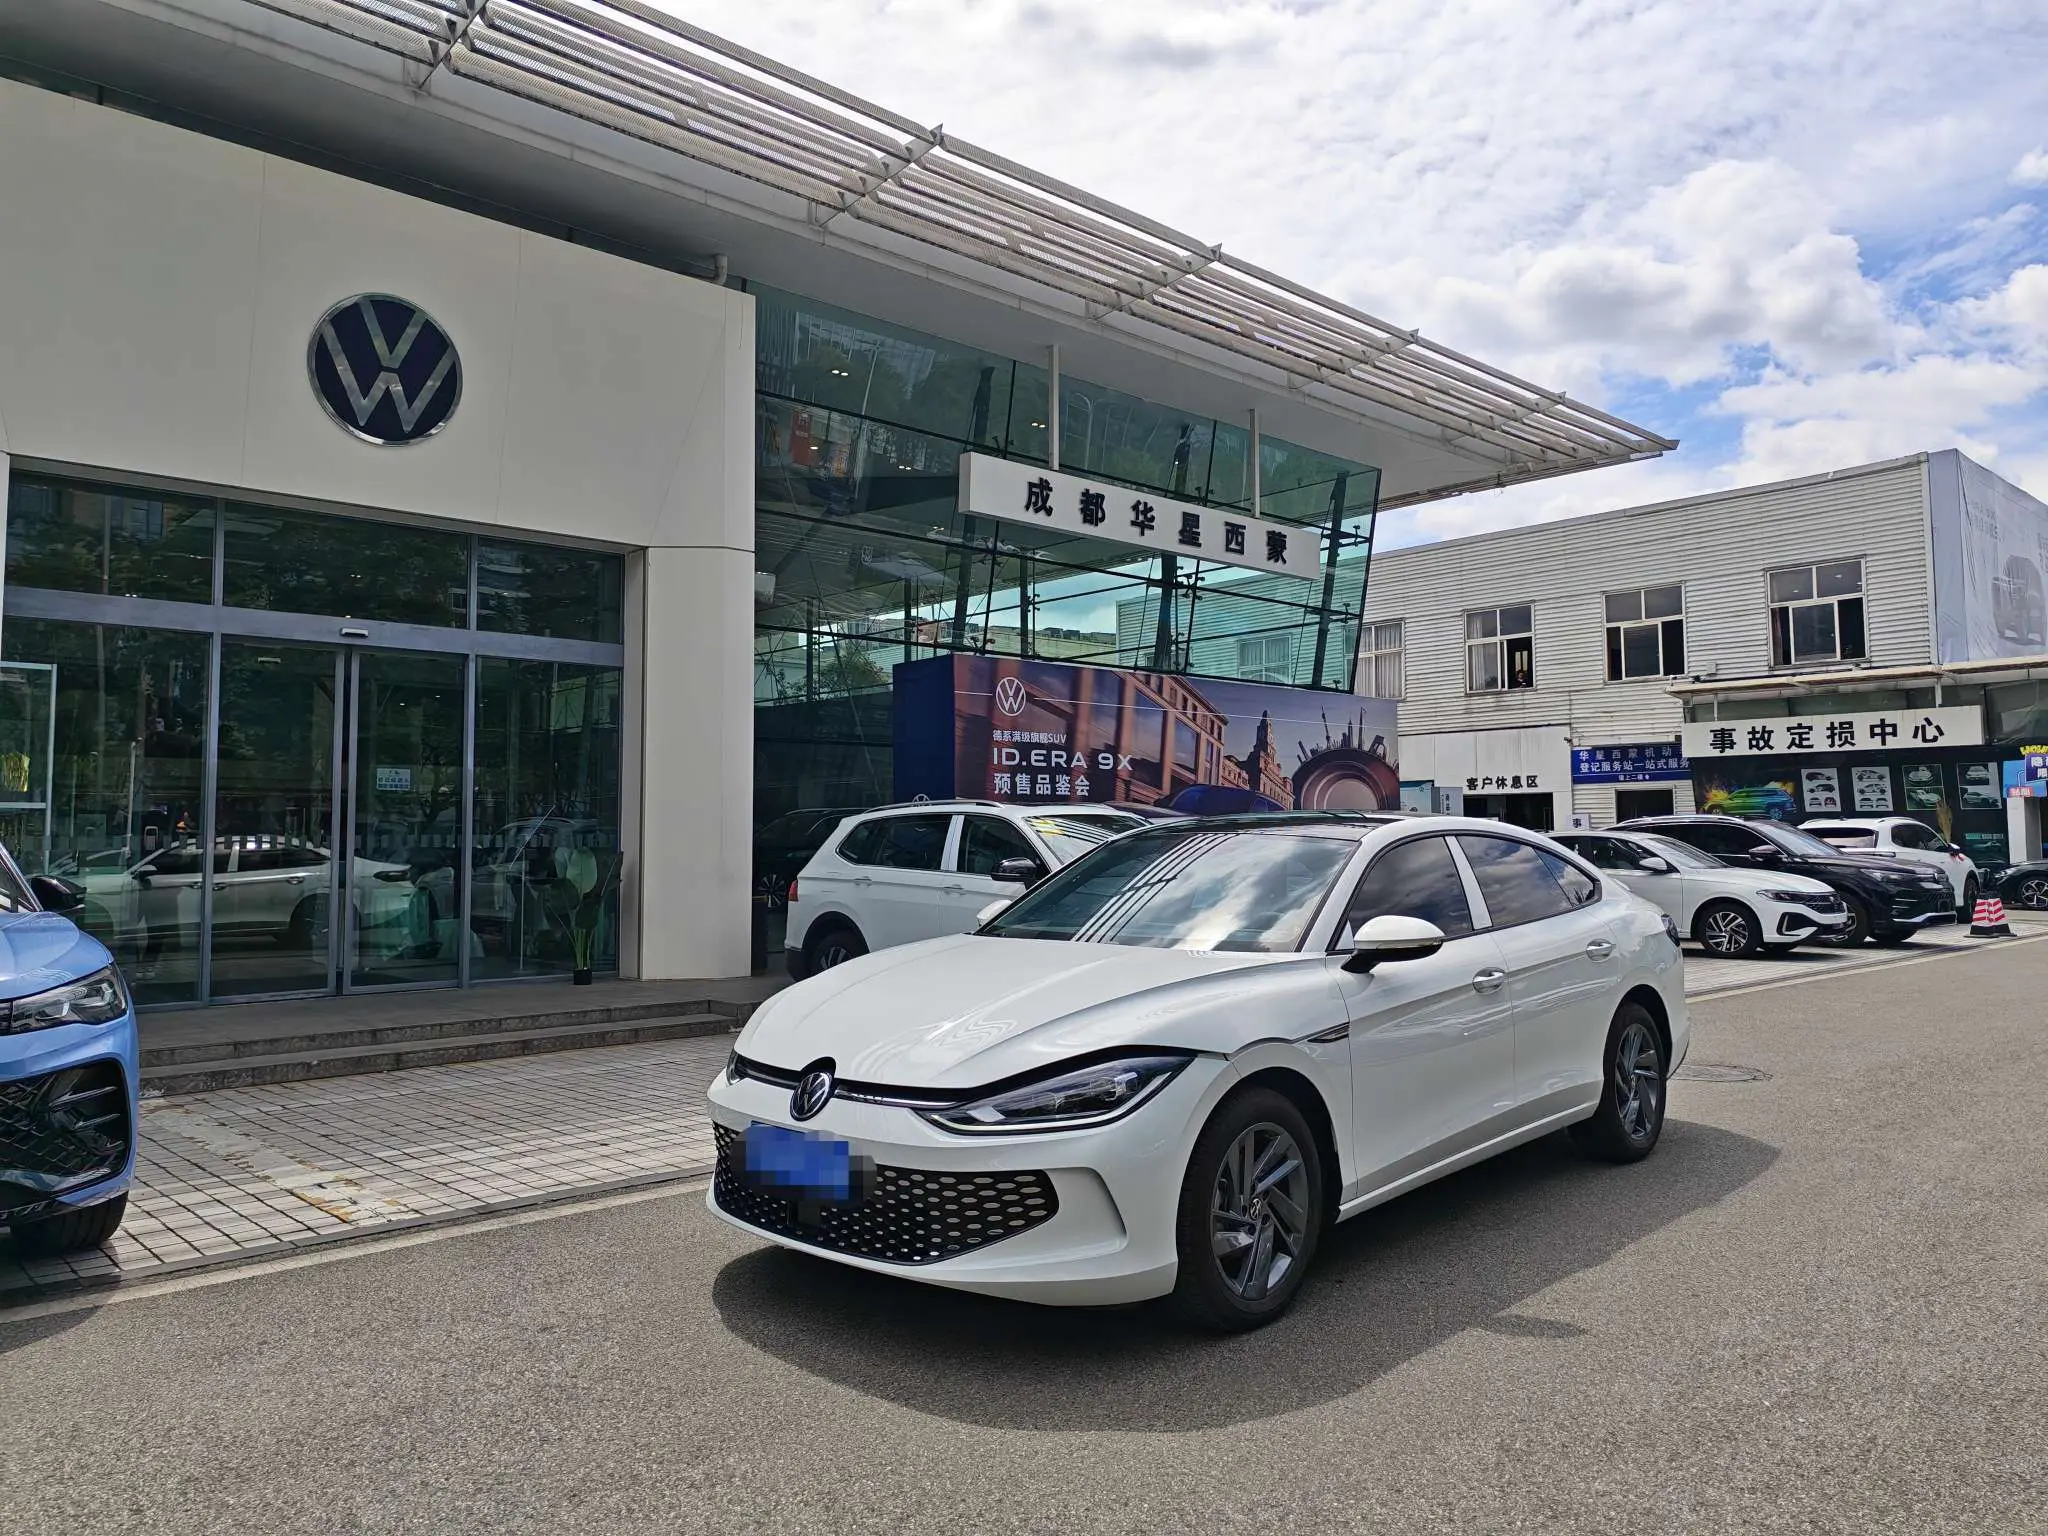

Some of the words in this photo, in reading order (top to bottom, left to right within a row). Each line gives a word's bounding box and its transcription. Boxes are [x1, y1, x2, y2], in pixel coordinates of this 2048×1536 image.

[309, 293, 463, 445] VW
[1025, 477, 1288, 564] 成都华星西蒙
[996, 677, 1026, 716] VW
[1709, 716, 1945, 754] 事故定损中心
[993, 747, 1088, 769] ID.ERA
[1097, 752, 1133, 771] 9X
[993, 772, 1091, 797] 预售品鉴会
[1466, 775, 1539, 791] 客户休息区
